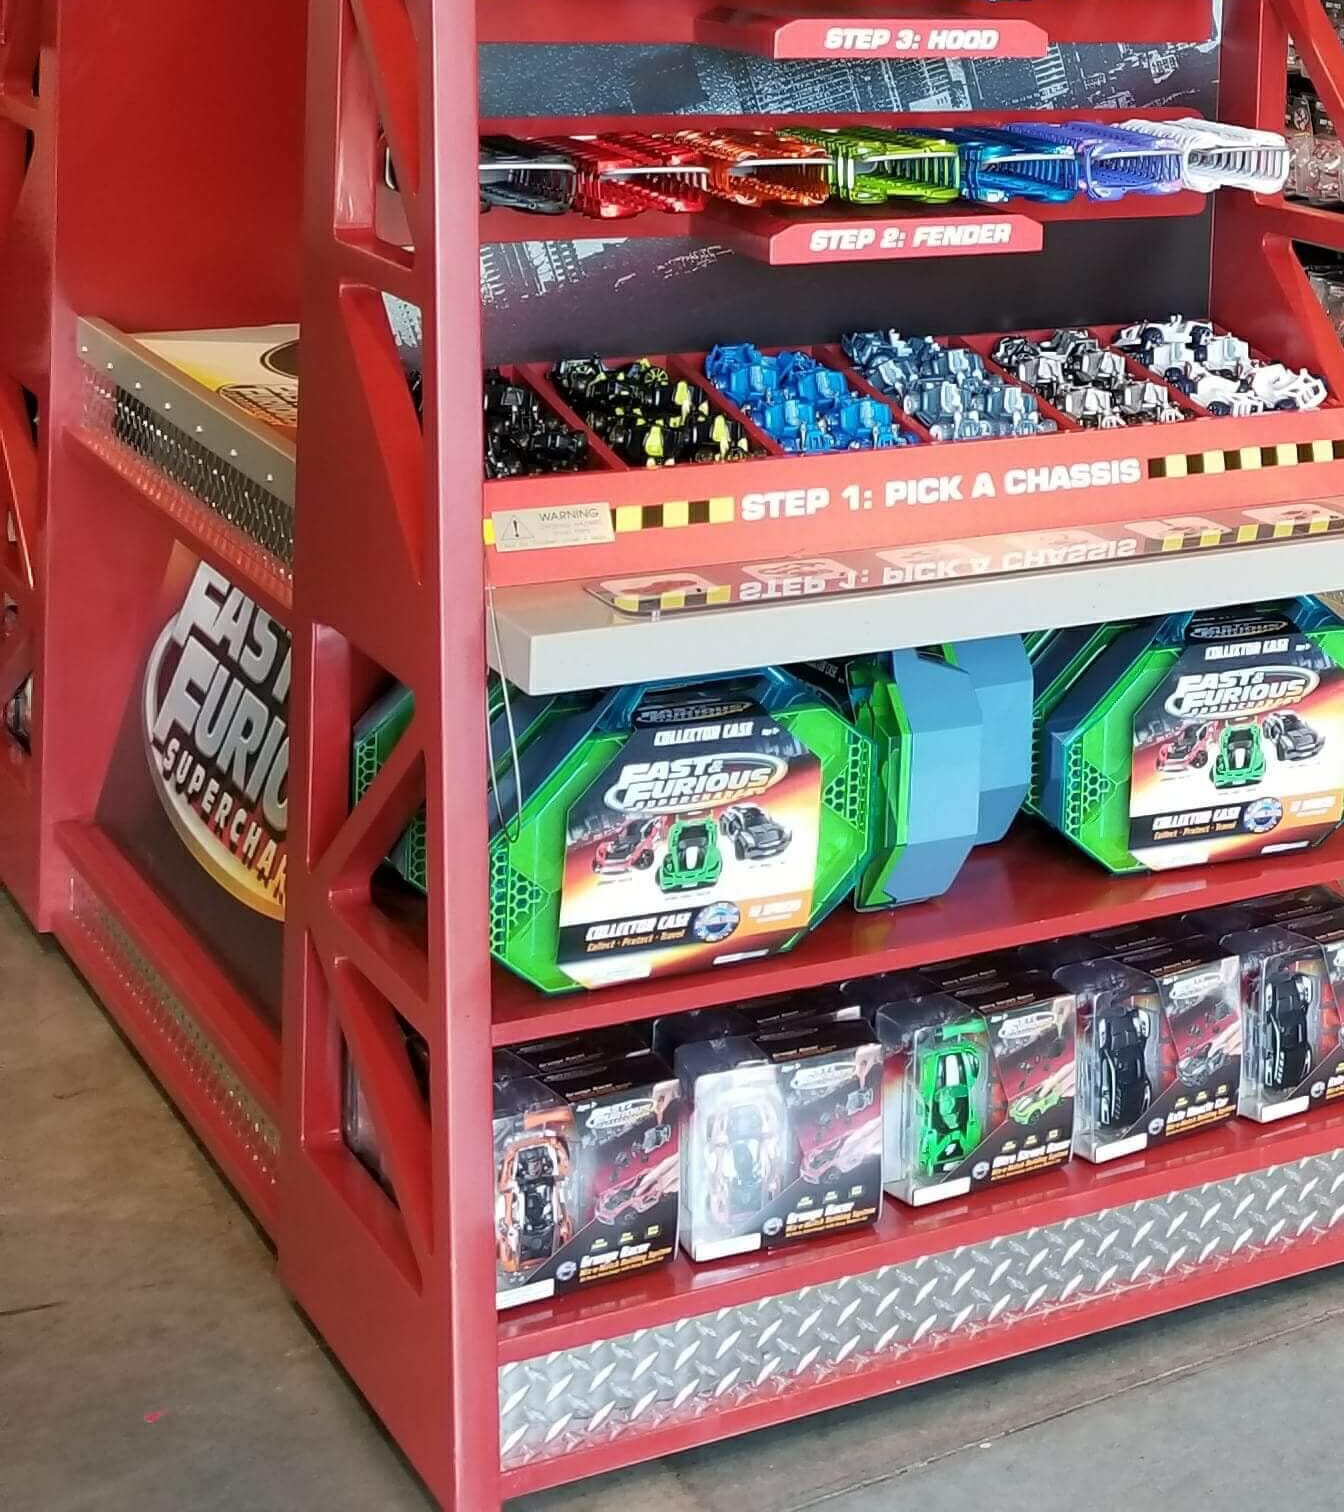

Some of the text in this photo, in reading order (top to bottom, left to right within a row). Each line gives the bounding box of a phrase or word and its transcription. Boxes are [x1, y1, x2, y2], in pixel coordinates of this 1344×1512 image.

[824, 27, 999, 50] STEP 3: HOOD
[809, 223, 1012, 252] STEP 2: FENDER
[742, 458, 1141, 521] STEP 1: PICK A CHASSIS
[539, 508, 598, 521] WARNING
[1181, 680, 1305, 715] FURIOUS
[623, 767, 774, 809] FURIOUS
